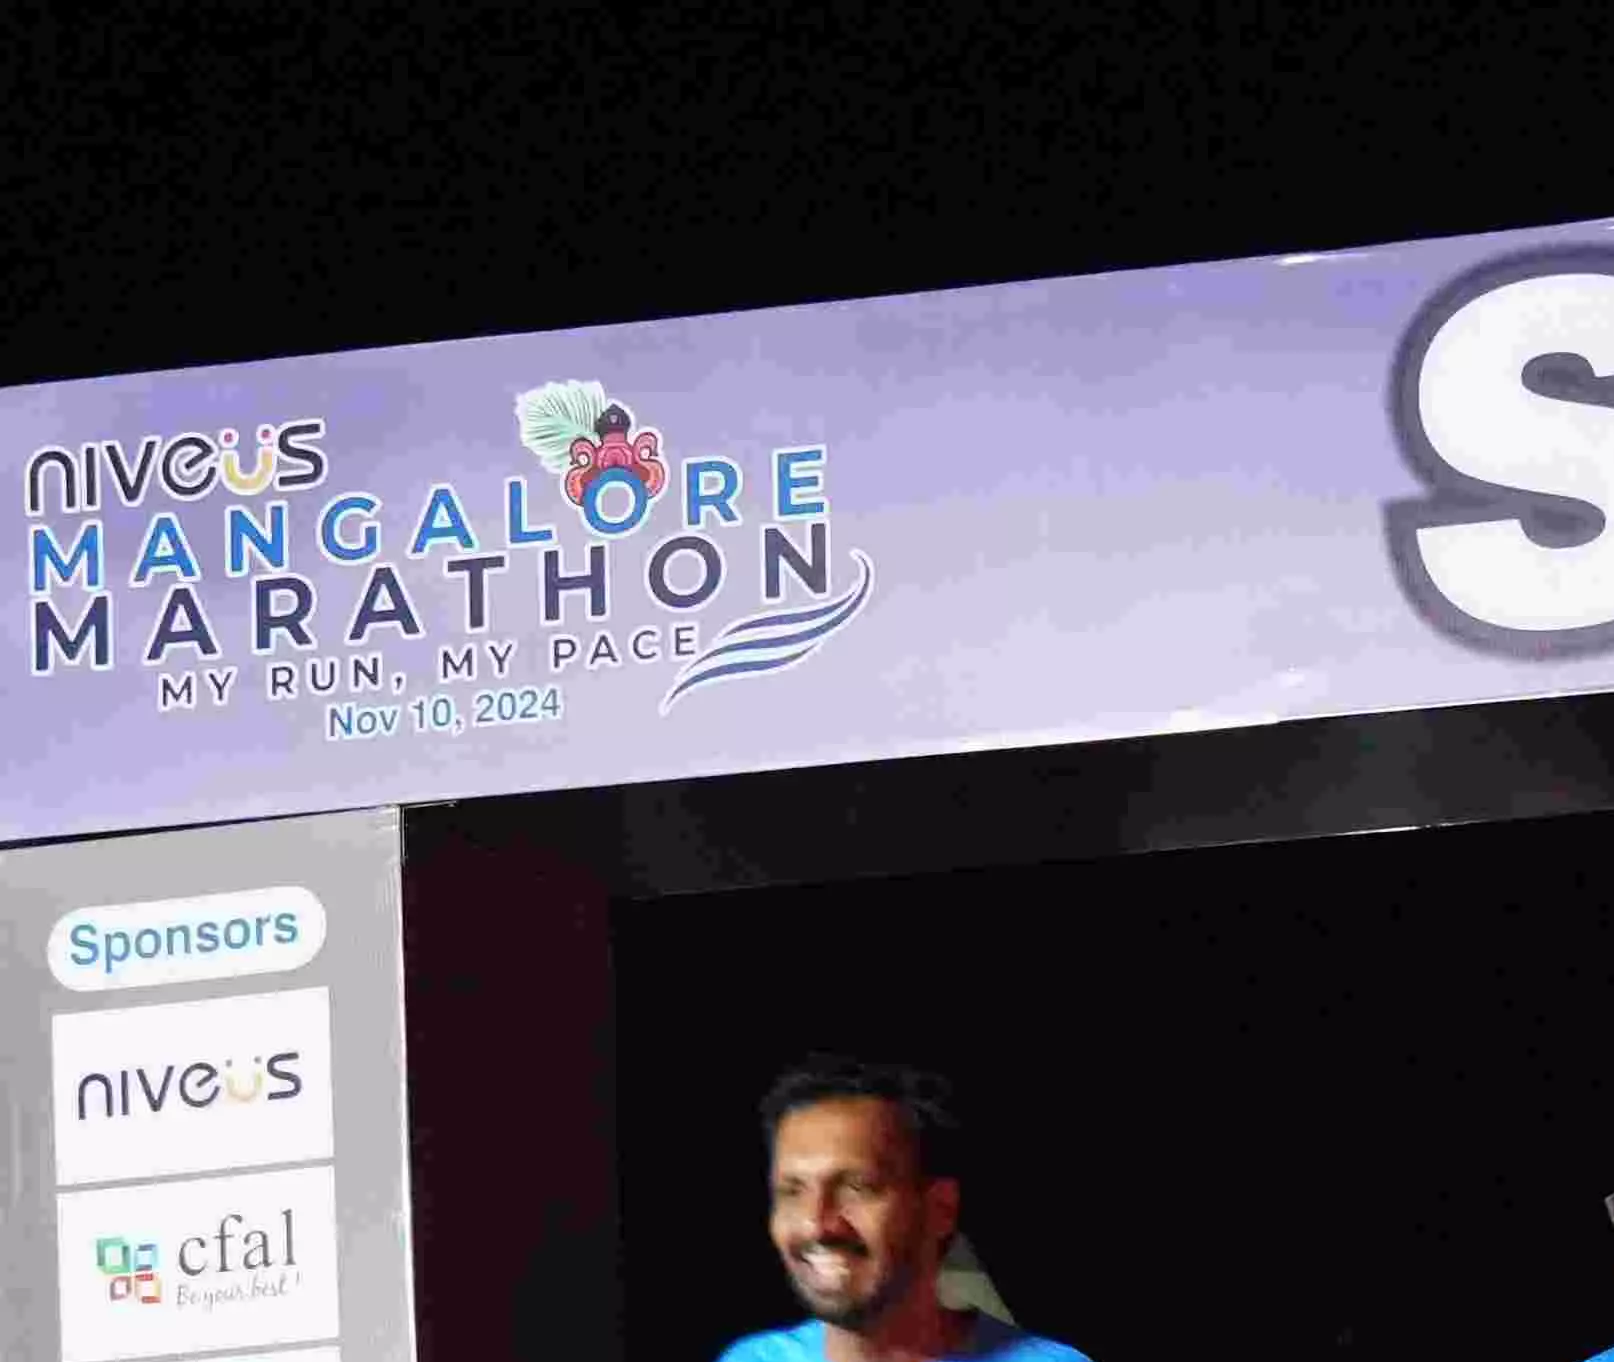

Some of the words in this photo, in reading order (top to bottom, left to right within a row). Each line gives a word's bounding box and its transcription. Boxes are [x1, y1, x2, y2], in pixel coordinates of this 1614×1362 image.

[32, 450, 825, 590] MANGALORE
[34, 523, 827, 671] MARATHON
[162, 670, 233, 708] MY
[271, 657, 405, 696] RUN,
[442, 643, 514, 680] MY
[553, 626, 697, 669] PACE
[329, 702, 398, 739] Nov
[411, 697, 462, 734] 10,
[476, 688, 562, 724] 2024
[70, 911, 299, 973] Sponsors
[178, 1208, 297, 1276] cfal
